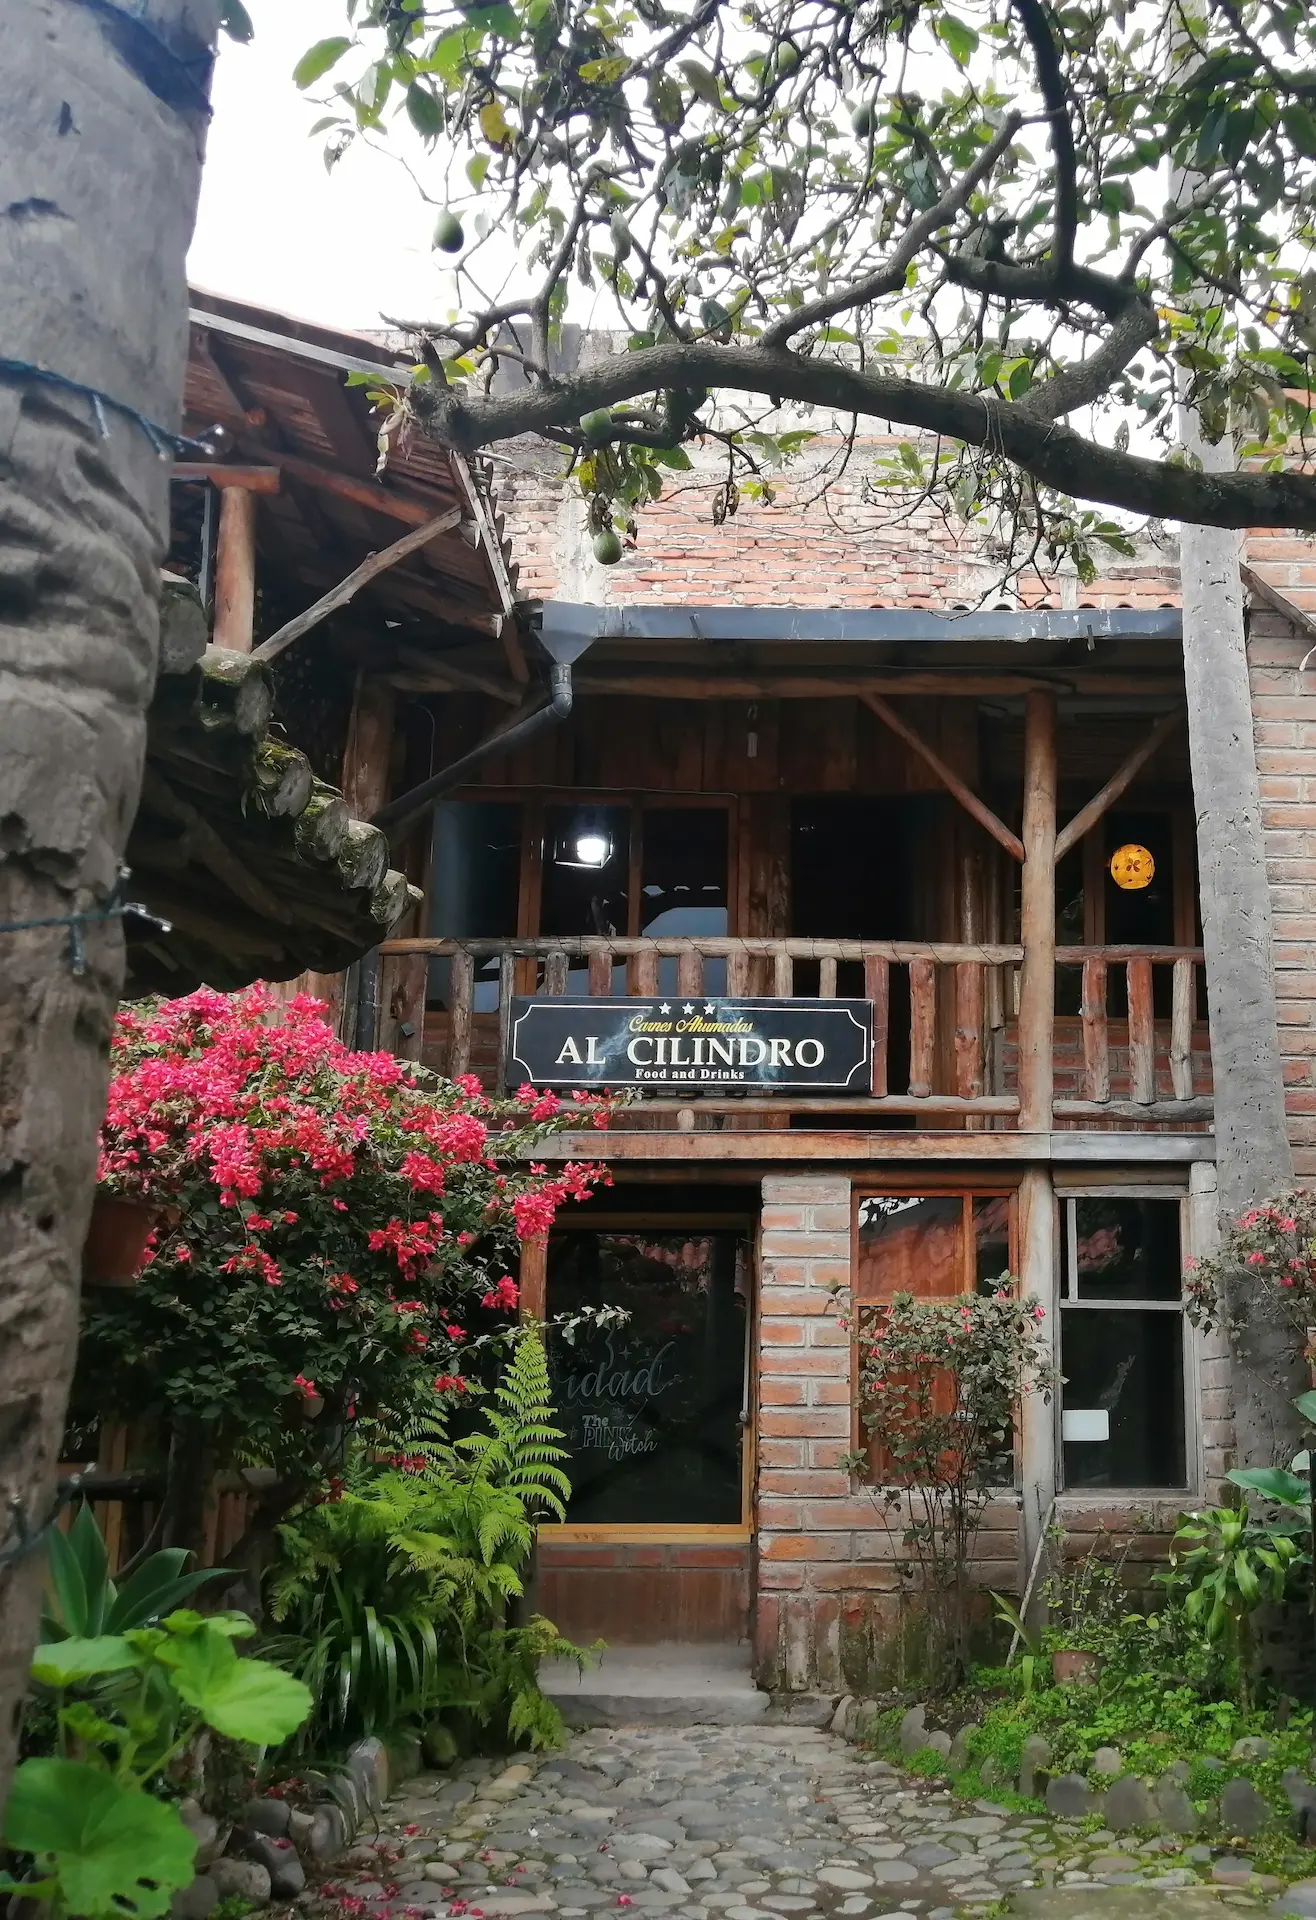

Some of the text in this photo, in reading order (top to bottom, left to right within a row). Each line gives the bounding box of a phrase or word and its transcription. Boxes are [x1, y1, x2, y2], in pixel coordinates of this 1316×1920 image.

[628, 1014, 754, 1034] Carnes Ahumadas
[554, 1036, 825, 1068] AL CILINDRO
[634, 1068, 746, 1081] Food and Drinks
[582, 1414, 609, 1428] The
